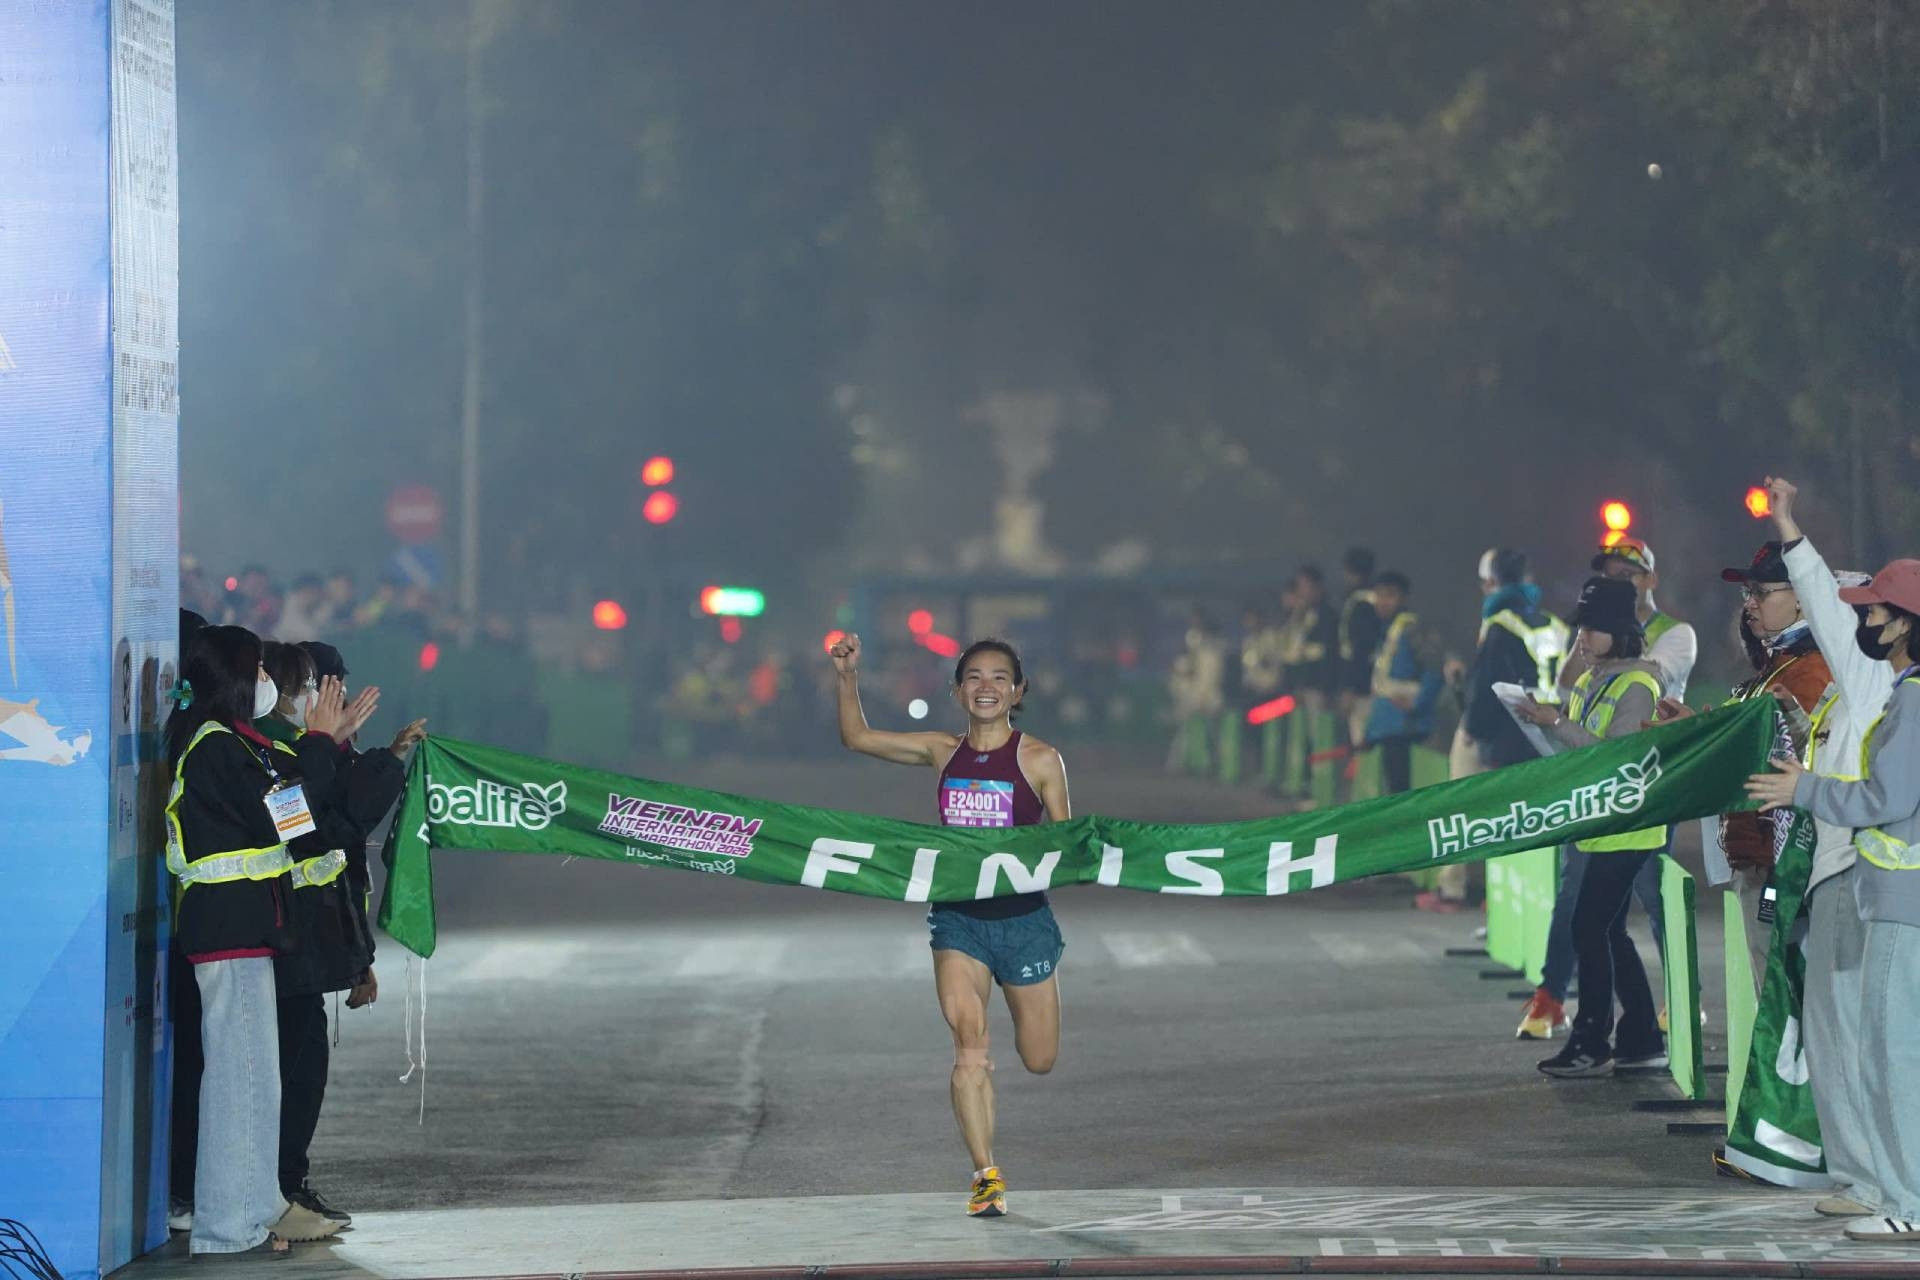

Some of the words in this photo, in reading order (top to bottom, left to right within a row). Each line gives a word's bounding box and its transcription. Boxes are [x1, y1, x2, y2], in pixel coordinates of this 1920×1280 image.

[609, 793, 764, 837] VIETNAM
[948, 790, 1000, 811] E24001
[1428, 776, 1645, 859] Herbalife
[597, 823, 638, 840] HALF
[636, 830, 717, 853] MARATHON
[716, 843, 754, 858] 2025
[603, 813, 754, 848] INTERNATIONAL
[801, 833, 1338, 902] FINISH
[1034, 960, 1051, 975] T8
